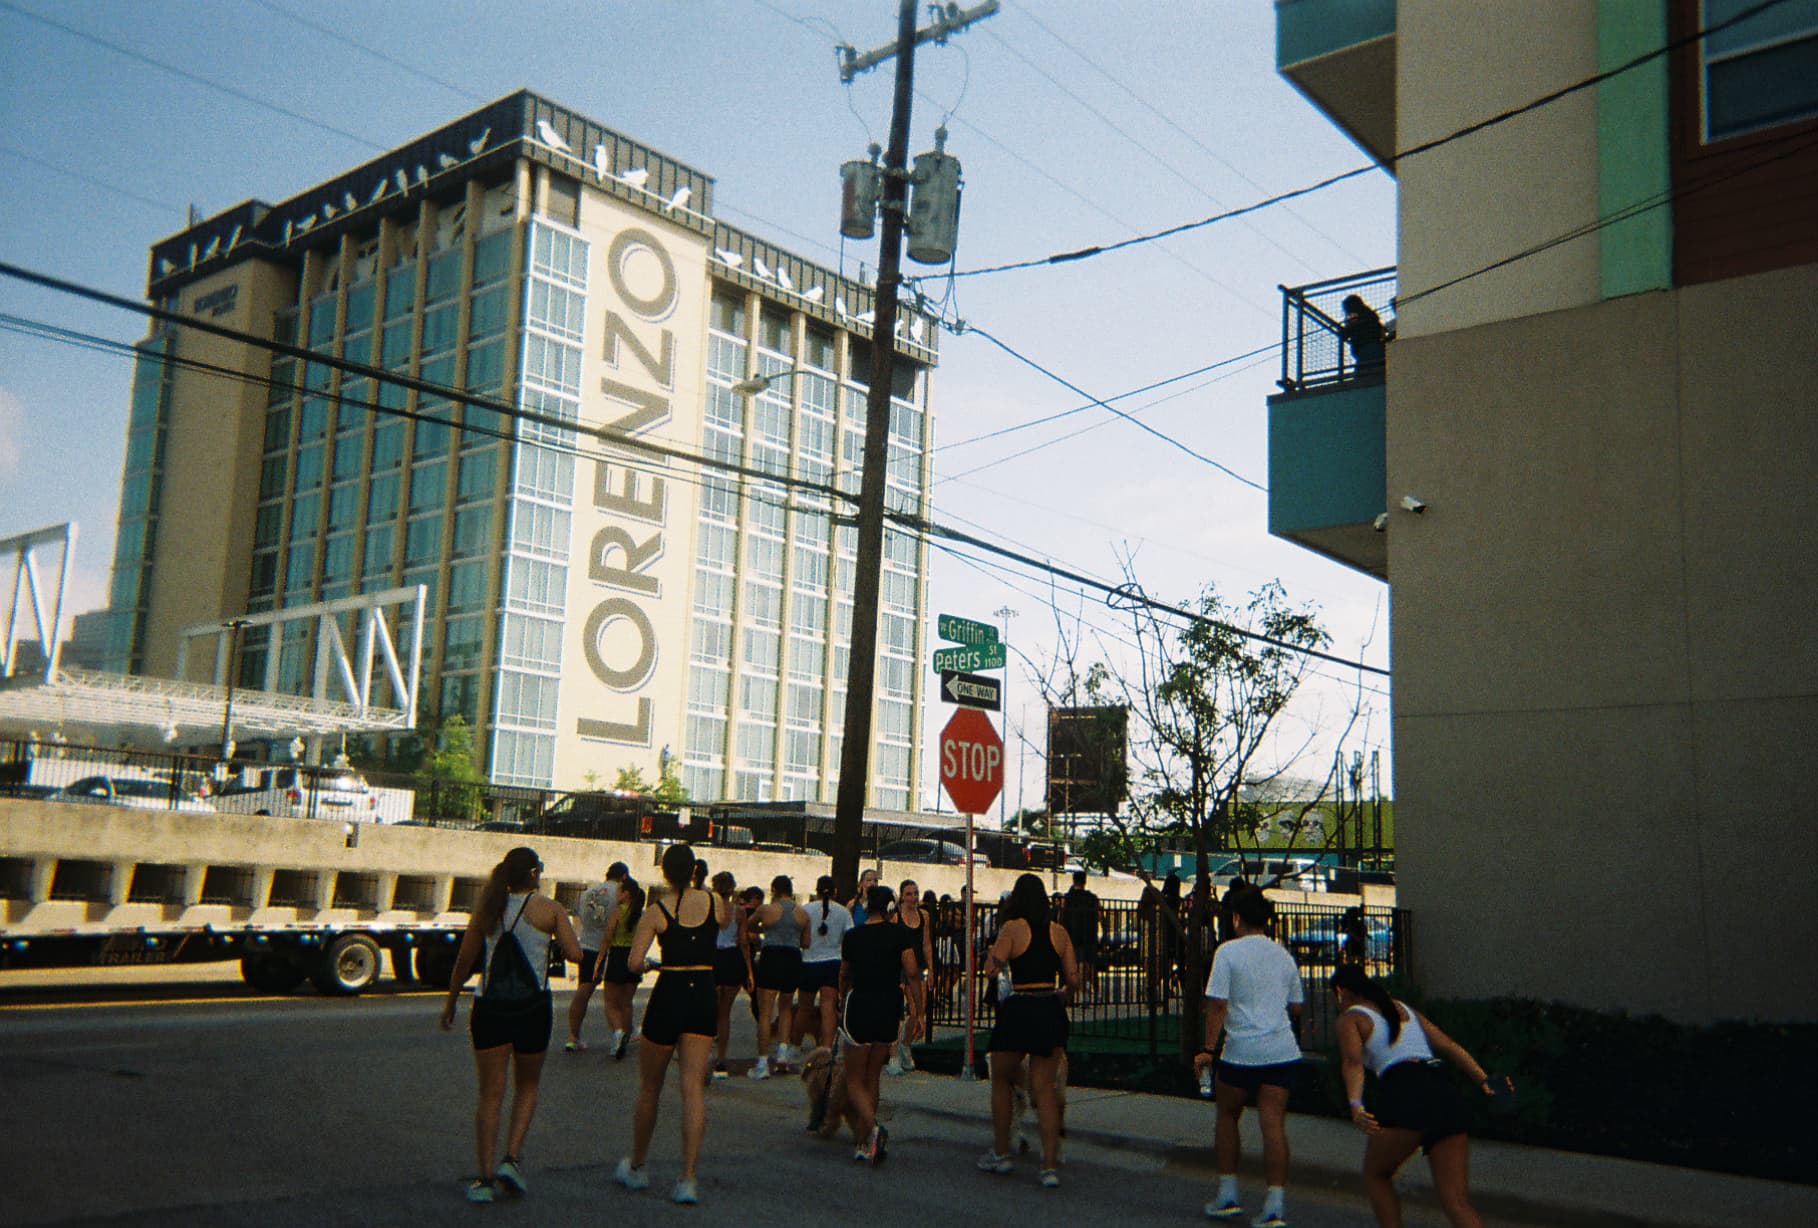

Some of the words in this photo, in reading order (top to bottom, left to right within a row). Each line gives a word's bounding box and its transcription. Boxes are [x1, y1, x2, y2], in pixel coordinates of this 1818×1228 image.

[576, 226, 679, 747] LORENZO
[948, 619, 984, 645] Griffin
[935, 650, 981, 672] Peters
[957, 682, 974, 696] ONE
[975, 686, 995, 700] WAY
[943, 739, 1000, 782] STOP
